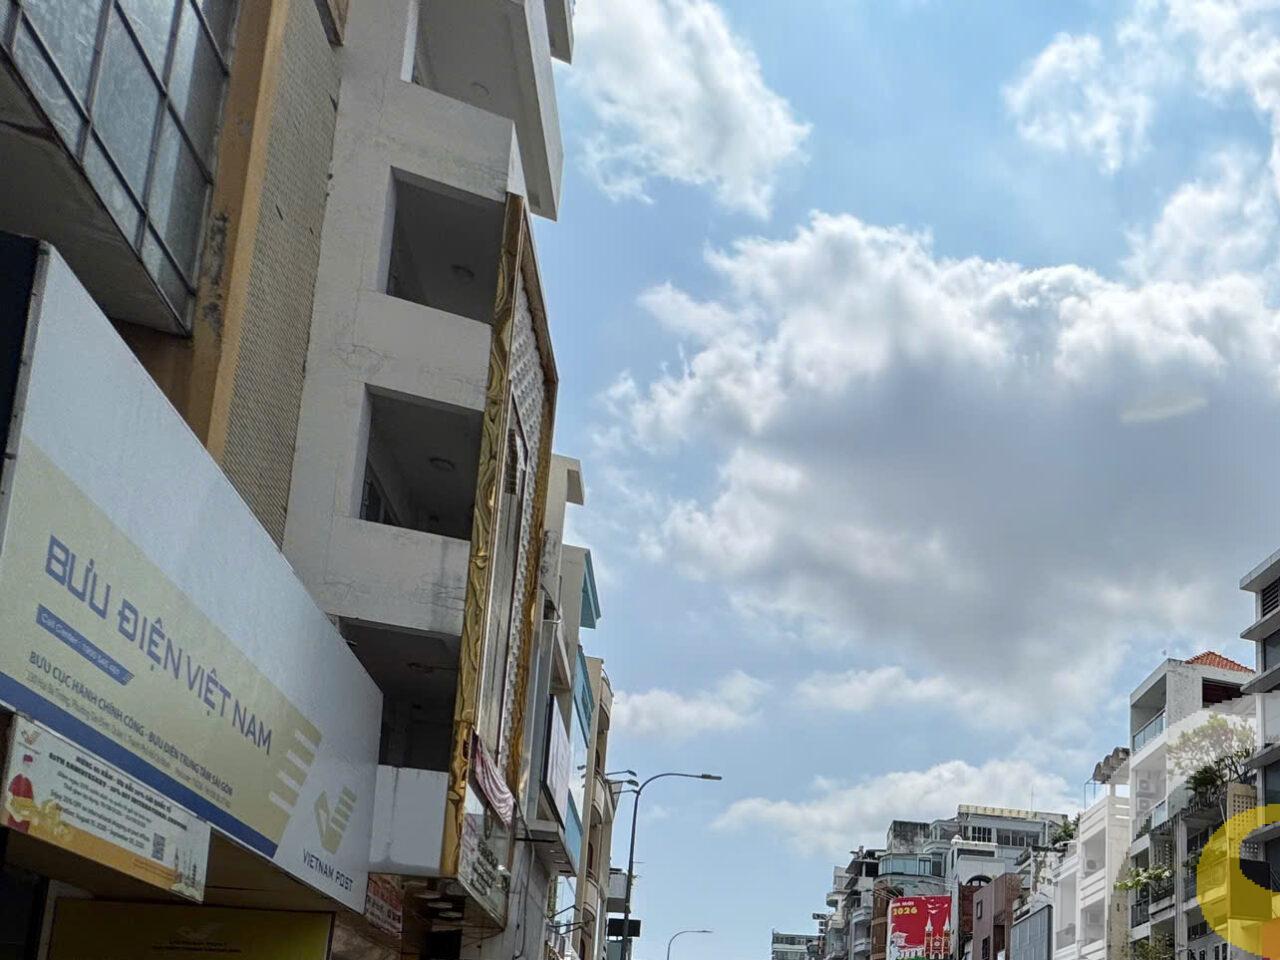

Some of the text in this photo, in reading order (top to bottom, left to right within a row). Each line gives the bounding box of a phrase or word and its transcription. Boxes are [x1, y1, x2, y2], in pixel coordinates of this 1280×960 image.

[46, 534, 112, 620] BƯU
[117, 598, 183, 680] ĐIỆN
[186, 655, 232, 717] VIỆT
[232, 699, 272, 756] NAM
[303, 848, 354, 892] VIETNAM POST
[892, 906, 918, 916] 2026
